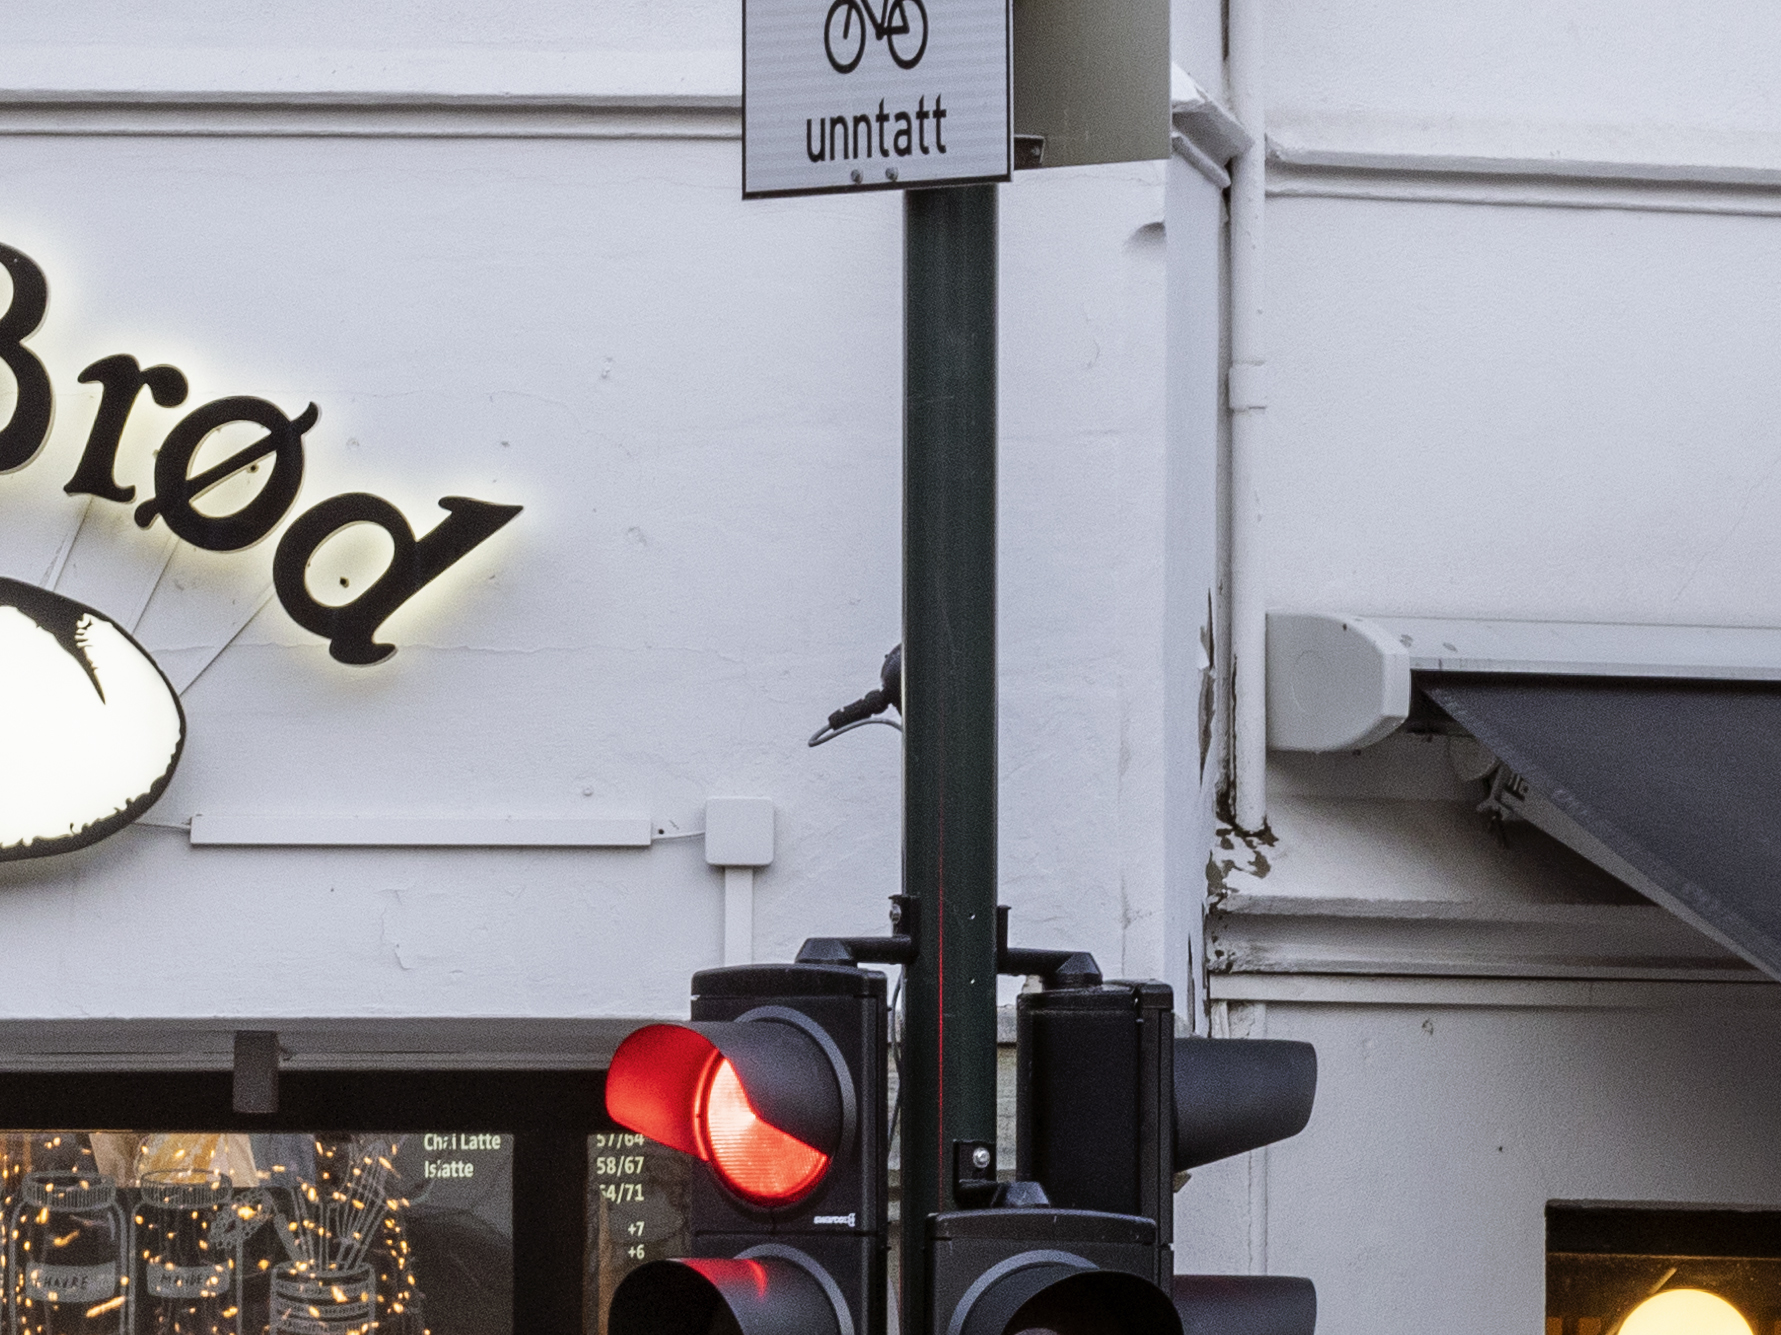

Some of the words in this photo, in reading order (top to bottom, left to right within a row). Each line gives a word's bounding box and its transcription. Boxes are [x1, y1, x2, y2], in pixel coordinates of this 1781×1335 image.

[806, 95, 947, 163] unntatt
[461, 1133, 502, 1151] Latte
[596, 1156, 645, 1177] 58/67
[628, 1221, 645, 1237] +7
[628, 1244, 645, 1260] +6
